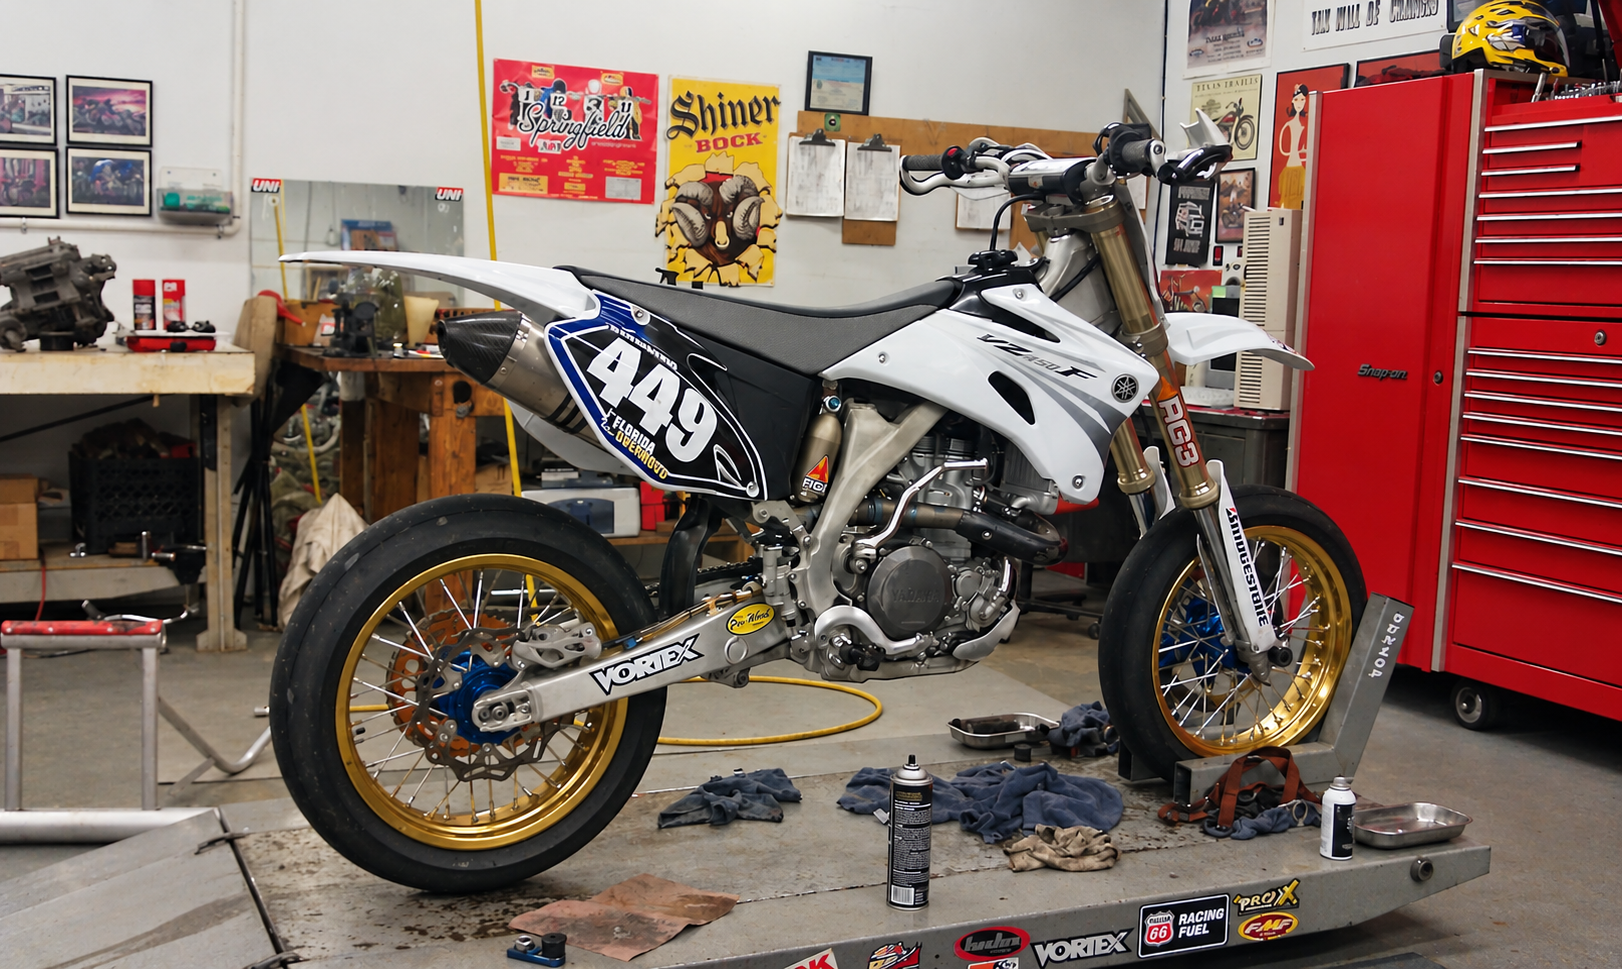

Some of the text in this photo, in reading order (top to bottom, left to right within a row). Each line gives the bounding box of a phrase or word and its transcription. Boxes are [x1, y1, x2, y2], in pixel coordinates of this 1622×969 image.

[518, 102, 633, 150] Springfield
[666, 89, 782, 140] Shiner
[695, 132, 763, 153] BOCK
[252, 179, 280, 193] UNI
[437, 188, 462, 201] UNI
[1357, 363, 1407, 381] Snap-on
[586, 337, 718, 463] 449
[612, 415, 656, 456] FLORIDA
[1158, 395, 1201, 468] RG3
[592, 635, 701, 695] VORTEX
[1149, 925, 1168, 941] 66
[1178, 907, 1225, 926] RACING
[1178, 922, 1210, 939] FUEL
[1244, 917, 1295, 935] FMF
[1034, 930, 1130, 968] VORTEX
